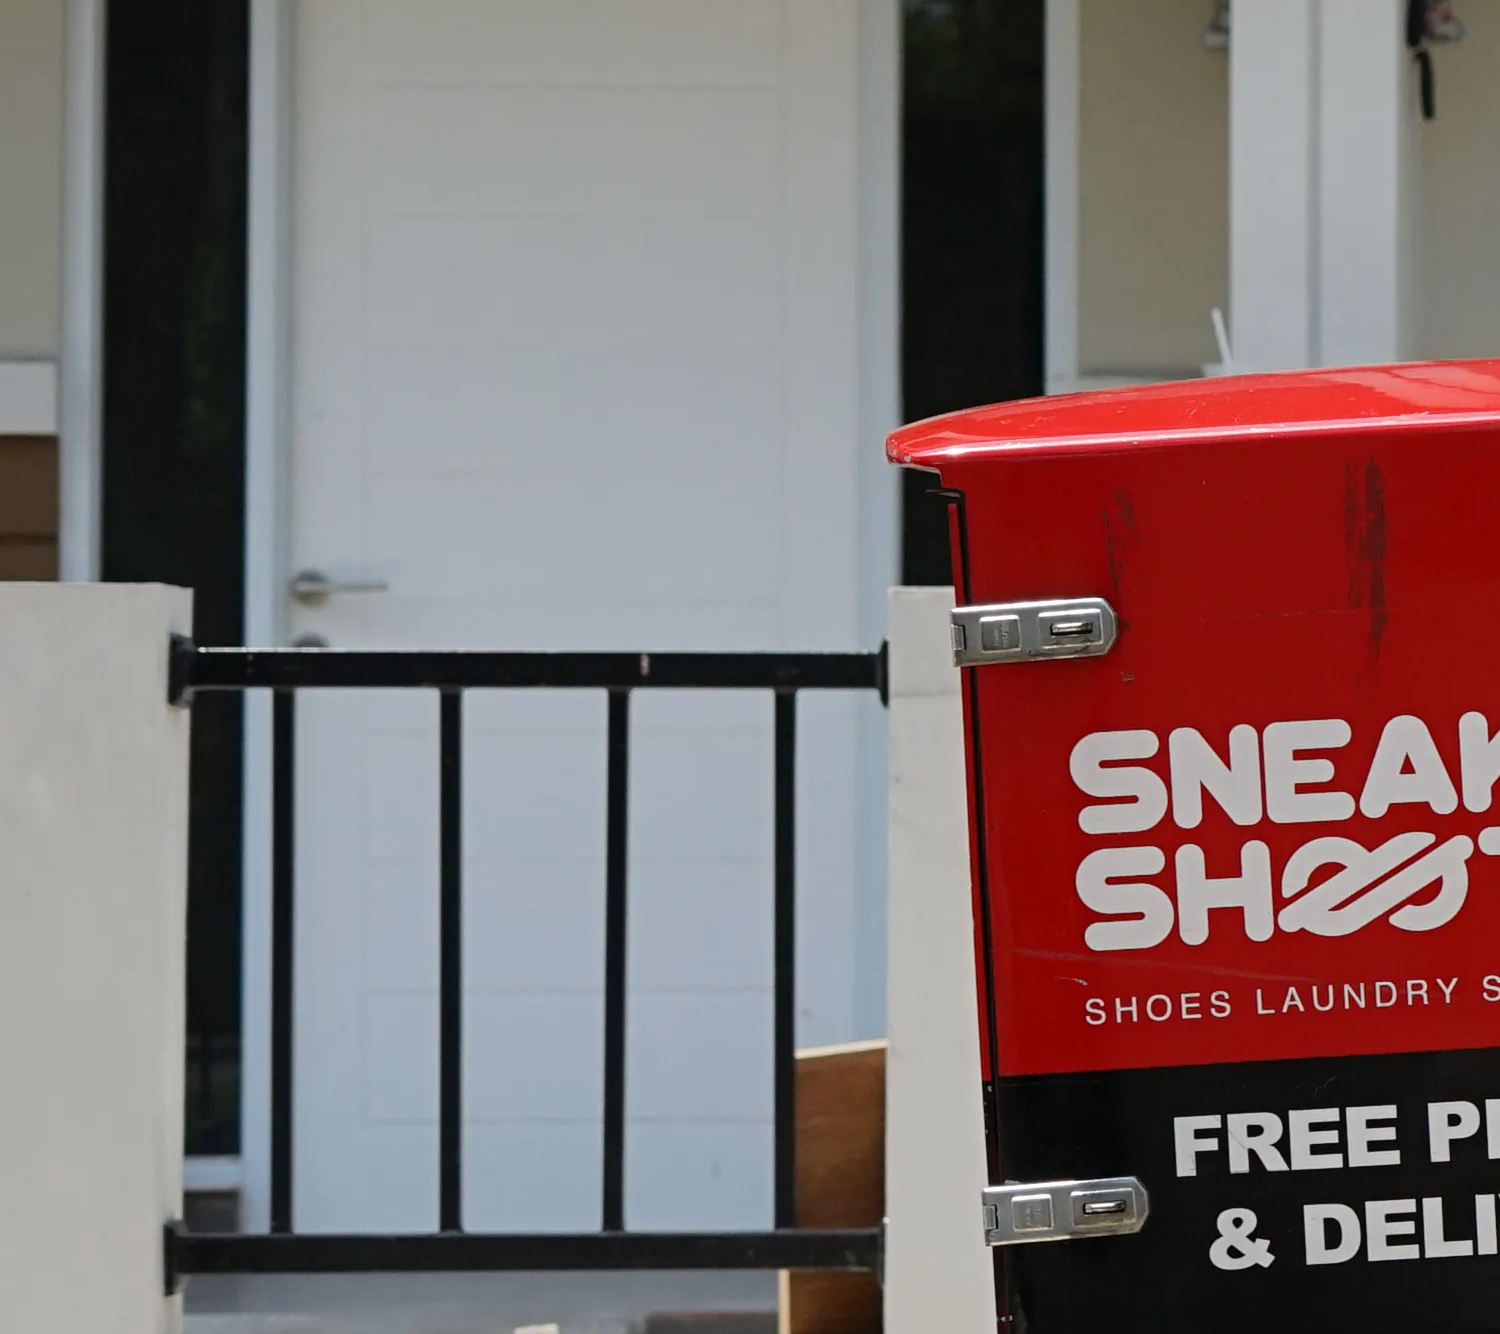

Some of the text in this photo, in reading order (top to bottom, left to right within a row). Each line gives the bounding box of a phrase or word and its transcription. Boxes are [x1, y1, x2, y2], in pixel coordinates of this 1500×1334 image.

[1083, 988, 1232, 1027] SHOES
[1255, 975, 1460, 1015] LAUNDRY
[1173, 1104, 1402, 1178] FREE
[1208, 1206, 1276, 1272] &
